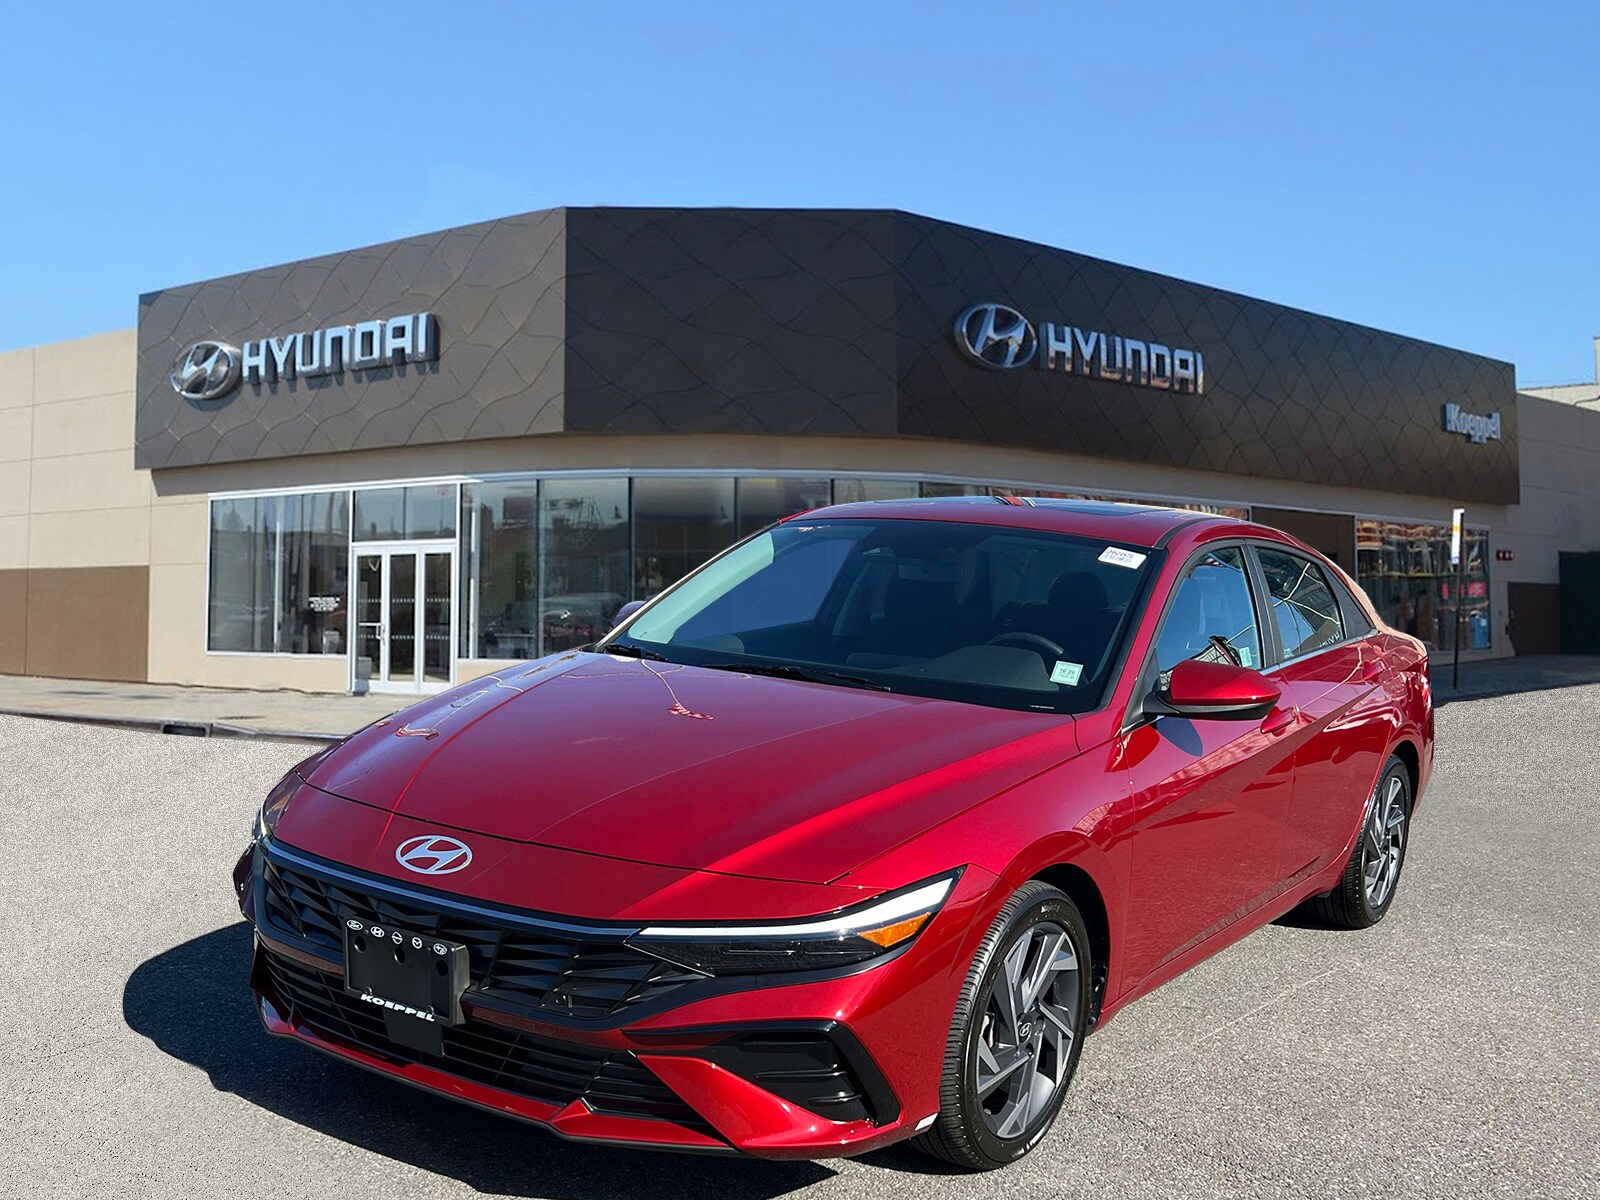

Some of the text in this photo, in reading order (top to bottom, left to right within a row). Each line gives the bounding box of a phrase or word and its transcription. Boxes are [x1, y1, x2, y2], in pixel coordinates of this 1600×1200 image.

[242, 311, 430, 382] HYUNDAI
[1045, 322, 1204, 395] HYUNDAI
[1445, 403, 1501, 444] Koeppel
[360, 993, 435, 1022] KOEPPEL
